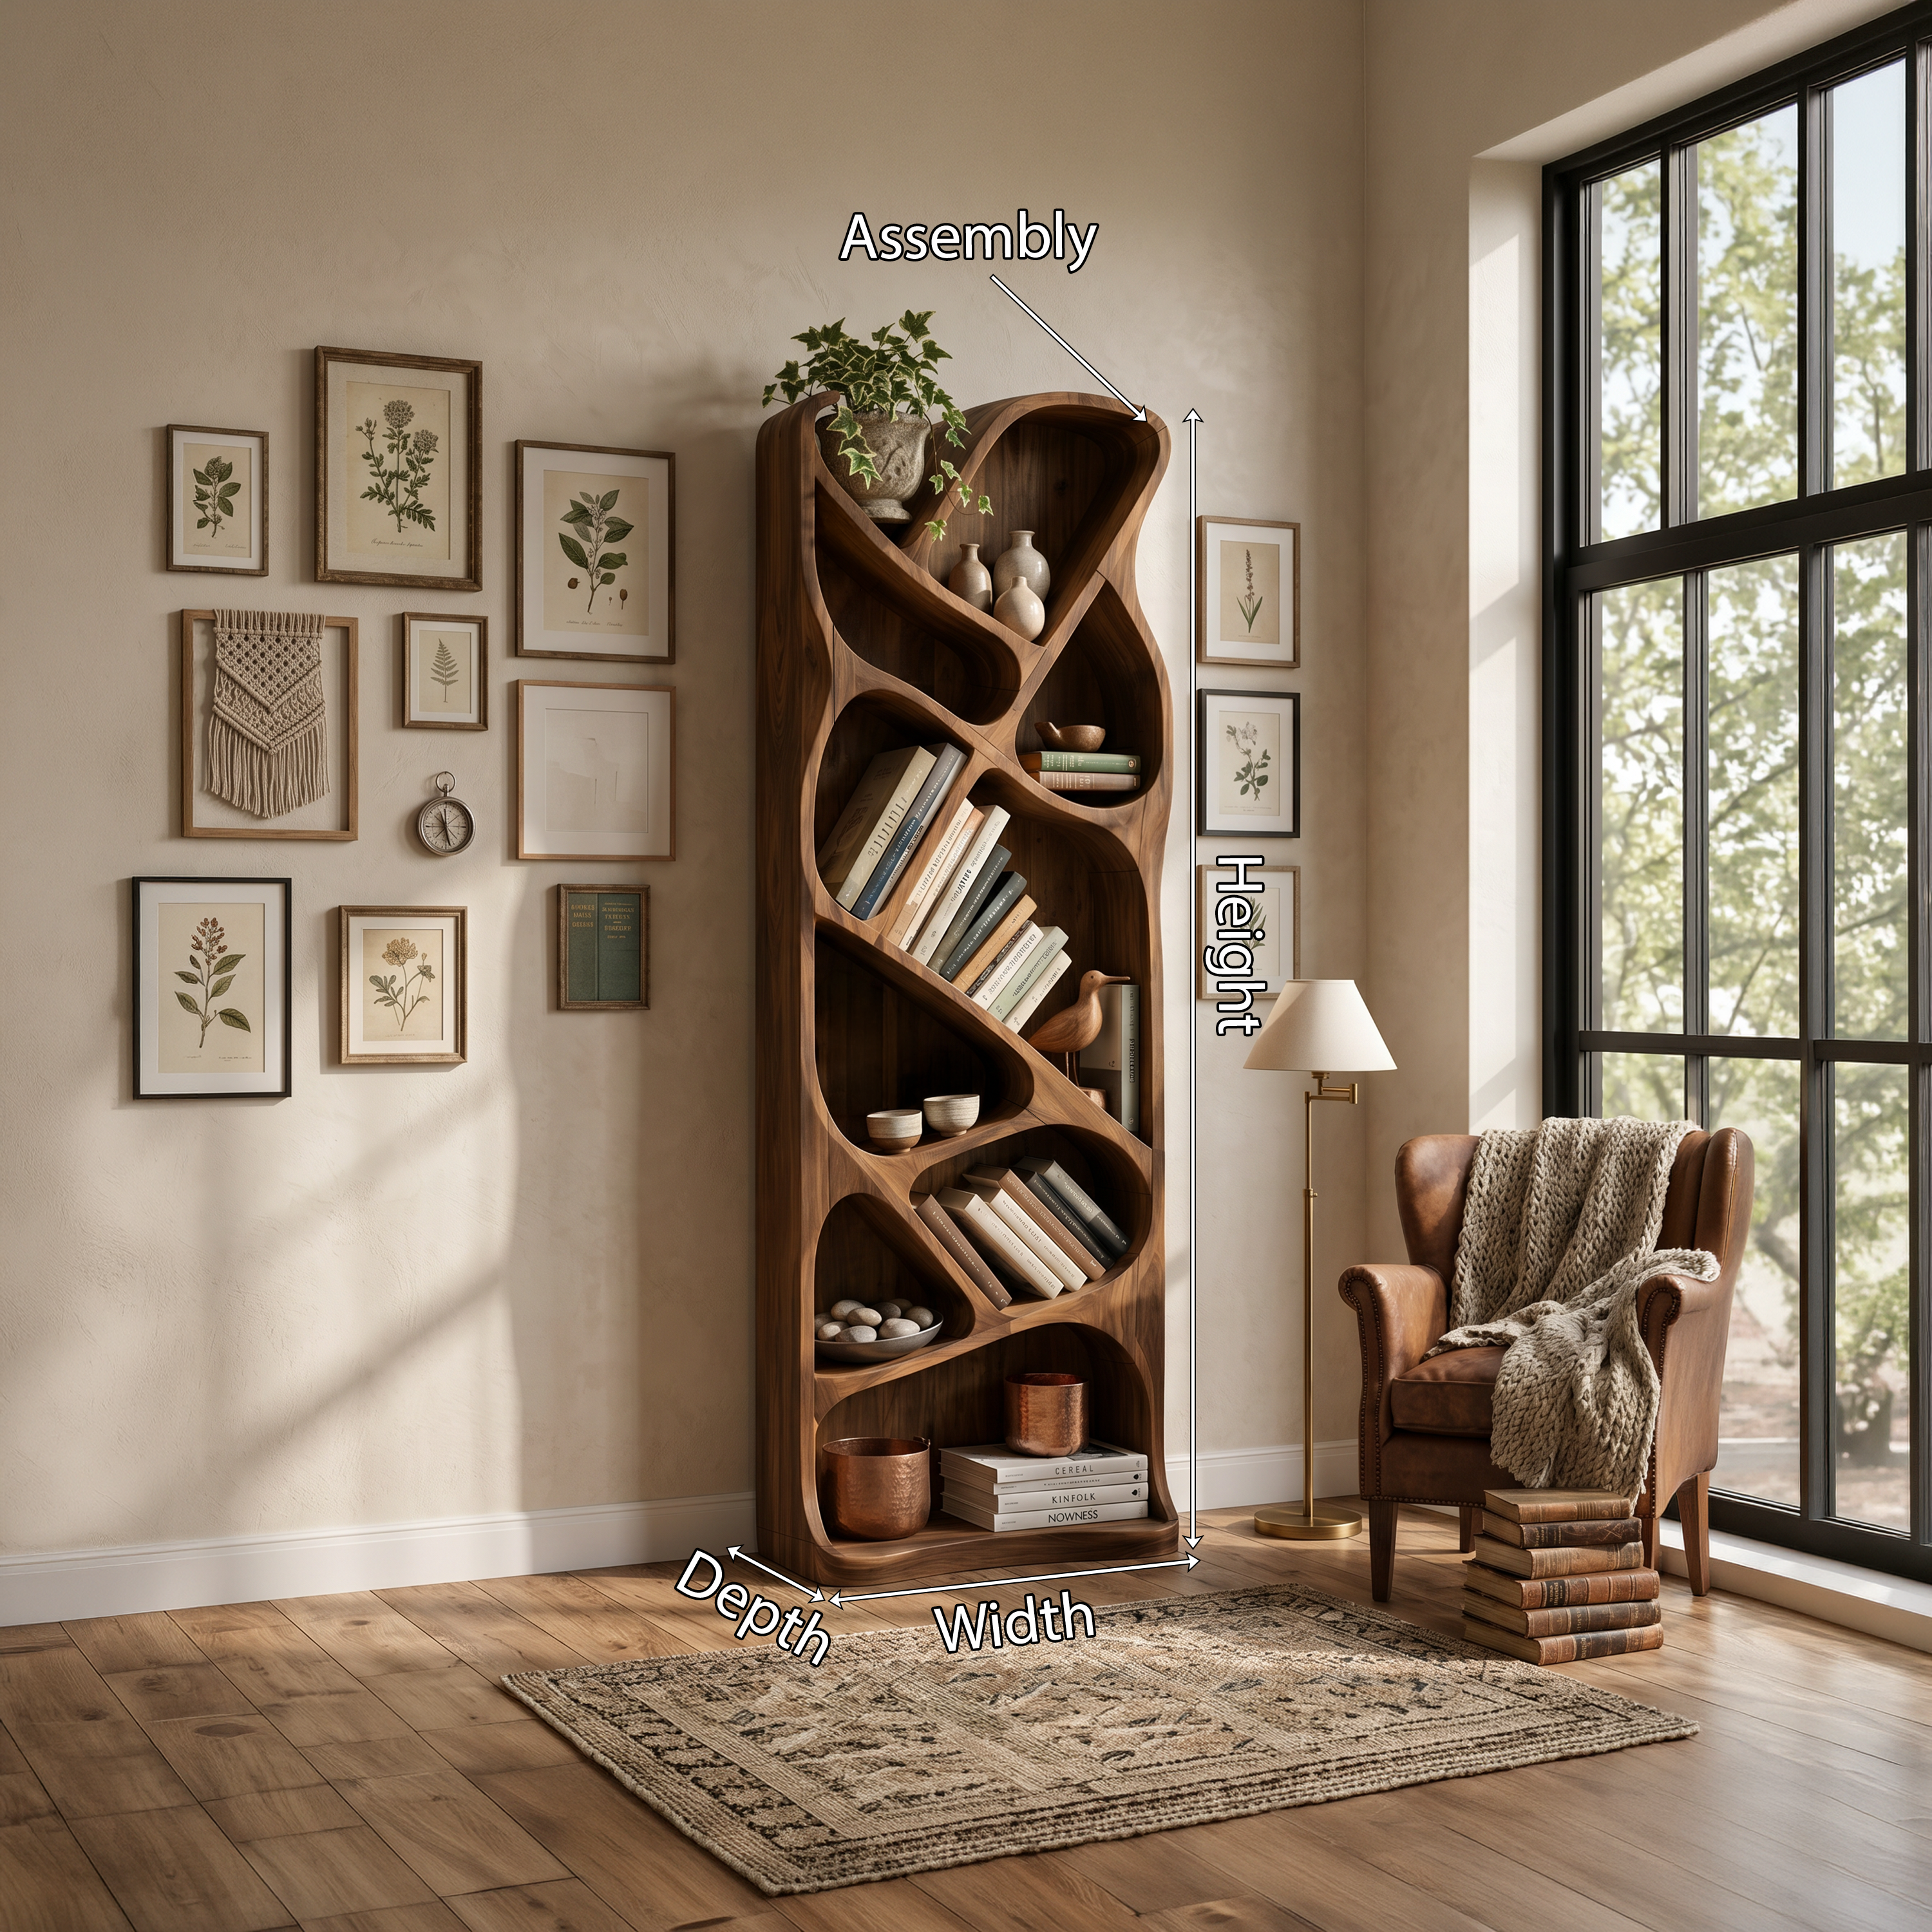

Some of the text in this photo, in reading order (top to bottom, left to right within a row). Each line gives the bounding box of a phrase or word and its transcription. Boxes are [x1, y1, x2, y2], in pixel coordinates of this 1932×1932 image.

[1055, 1465, 1094, 1475] CEREAL
[1052, 1492, 1096, 1504] KINFOLK
[1048, 1510, 1099, 1524] NOWNESS
